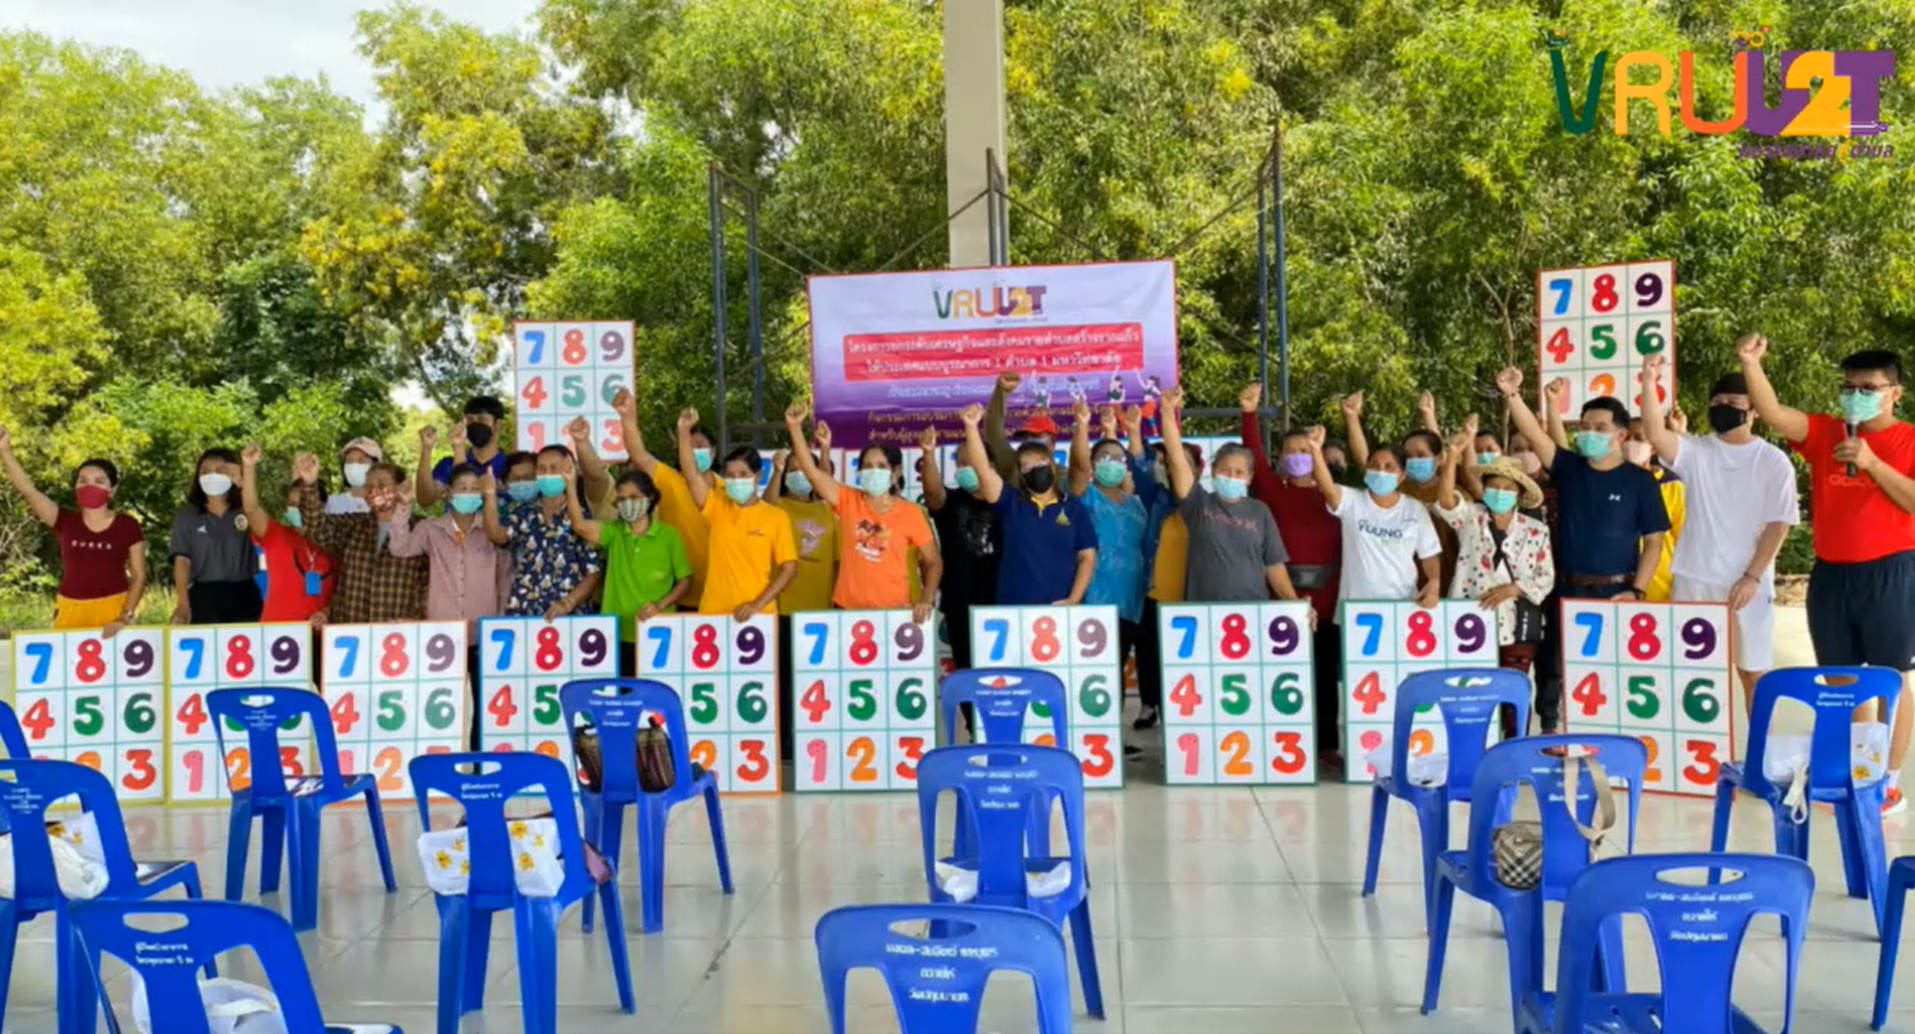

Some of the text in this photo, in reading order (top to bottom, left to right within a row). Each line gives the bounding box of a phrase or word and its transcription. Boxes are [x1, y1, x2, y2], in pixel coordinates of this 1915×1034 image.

[1549, 272, 1663, 315] 7 8 9
[523, 329, 625, 365] 7 8 9
[1546, 320, 1665, 364] 4 5 6
[522, 376, 548, 410] 4
[562, 375, 586, 407] 5
[527, 419, 625, 453] 1 3
[333, 633, 456, 678] 7 8 9
[489, 626, 607, 672] 7 8 9
[645, 624, 765, 671] 7 8 9
[803, 620, 925, 666] 7 8 9
[982, 615, 1108, 662] 7 8 9
[1169, 613, 1299, 660] 7 8 9
[1354, 612, 1385, 657] 7
[1405, 610, 1438, 657] 8
[1455, 613, 1486, 654] 9
[1573, 611, 1605, 658] 7
[1626, 612, 1662, 661] 8
[1681, 617, 1717, 660] 9
[23, 639, 154, 685] 7 8 9
[177, 634, 300, 680] 7 8 9
[177, 693, 208, 736] 4
[331, 688, 456, 734] 4 5 6
[488, 684, 518, 728] 4
[534, 684, 562, 726] 5
[690, 682, 719, 725] 5
[737, 682, 768, 724] 6
[800, 679, 831, 723] 4
[847, 678, 878, 721] 5
[896, 678, 928, 721] 6
[1079, 674, 1112, 718] 6
[1170, 672, 1303, 717] 4 5 6
[1352, 671, 1387, 715] 4
[1571, 672, 1720, 724] 4 5 6
[22, 693, 155, 741] 4 5 6
[122, 748, 157, 792] 3
[183, 750, 204, 793] 1
[373, 746, 403, 791] 2
[737, 740, 769, 783] 3
[806, 736, 924, 782] 1 2 3
[1081, 733, 1115, 777] 3
[1176, 731, 1307, 777] 1 2 3
[1683, 739, 1721, 786] 3
